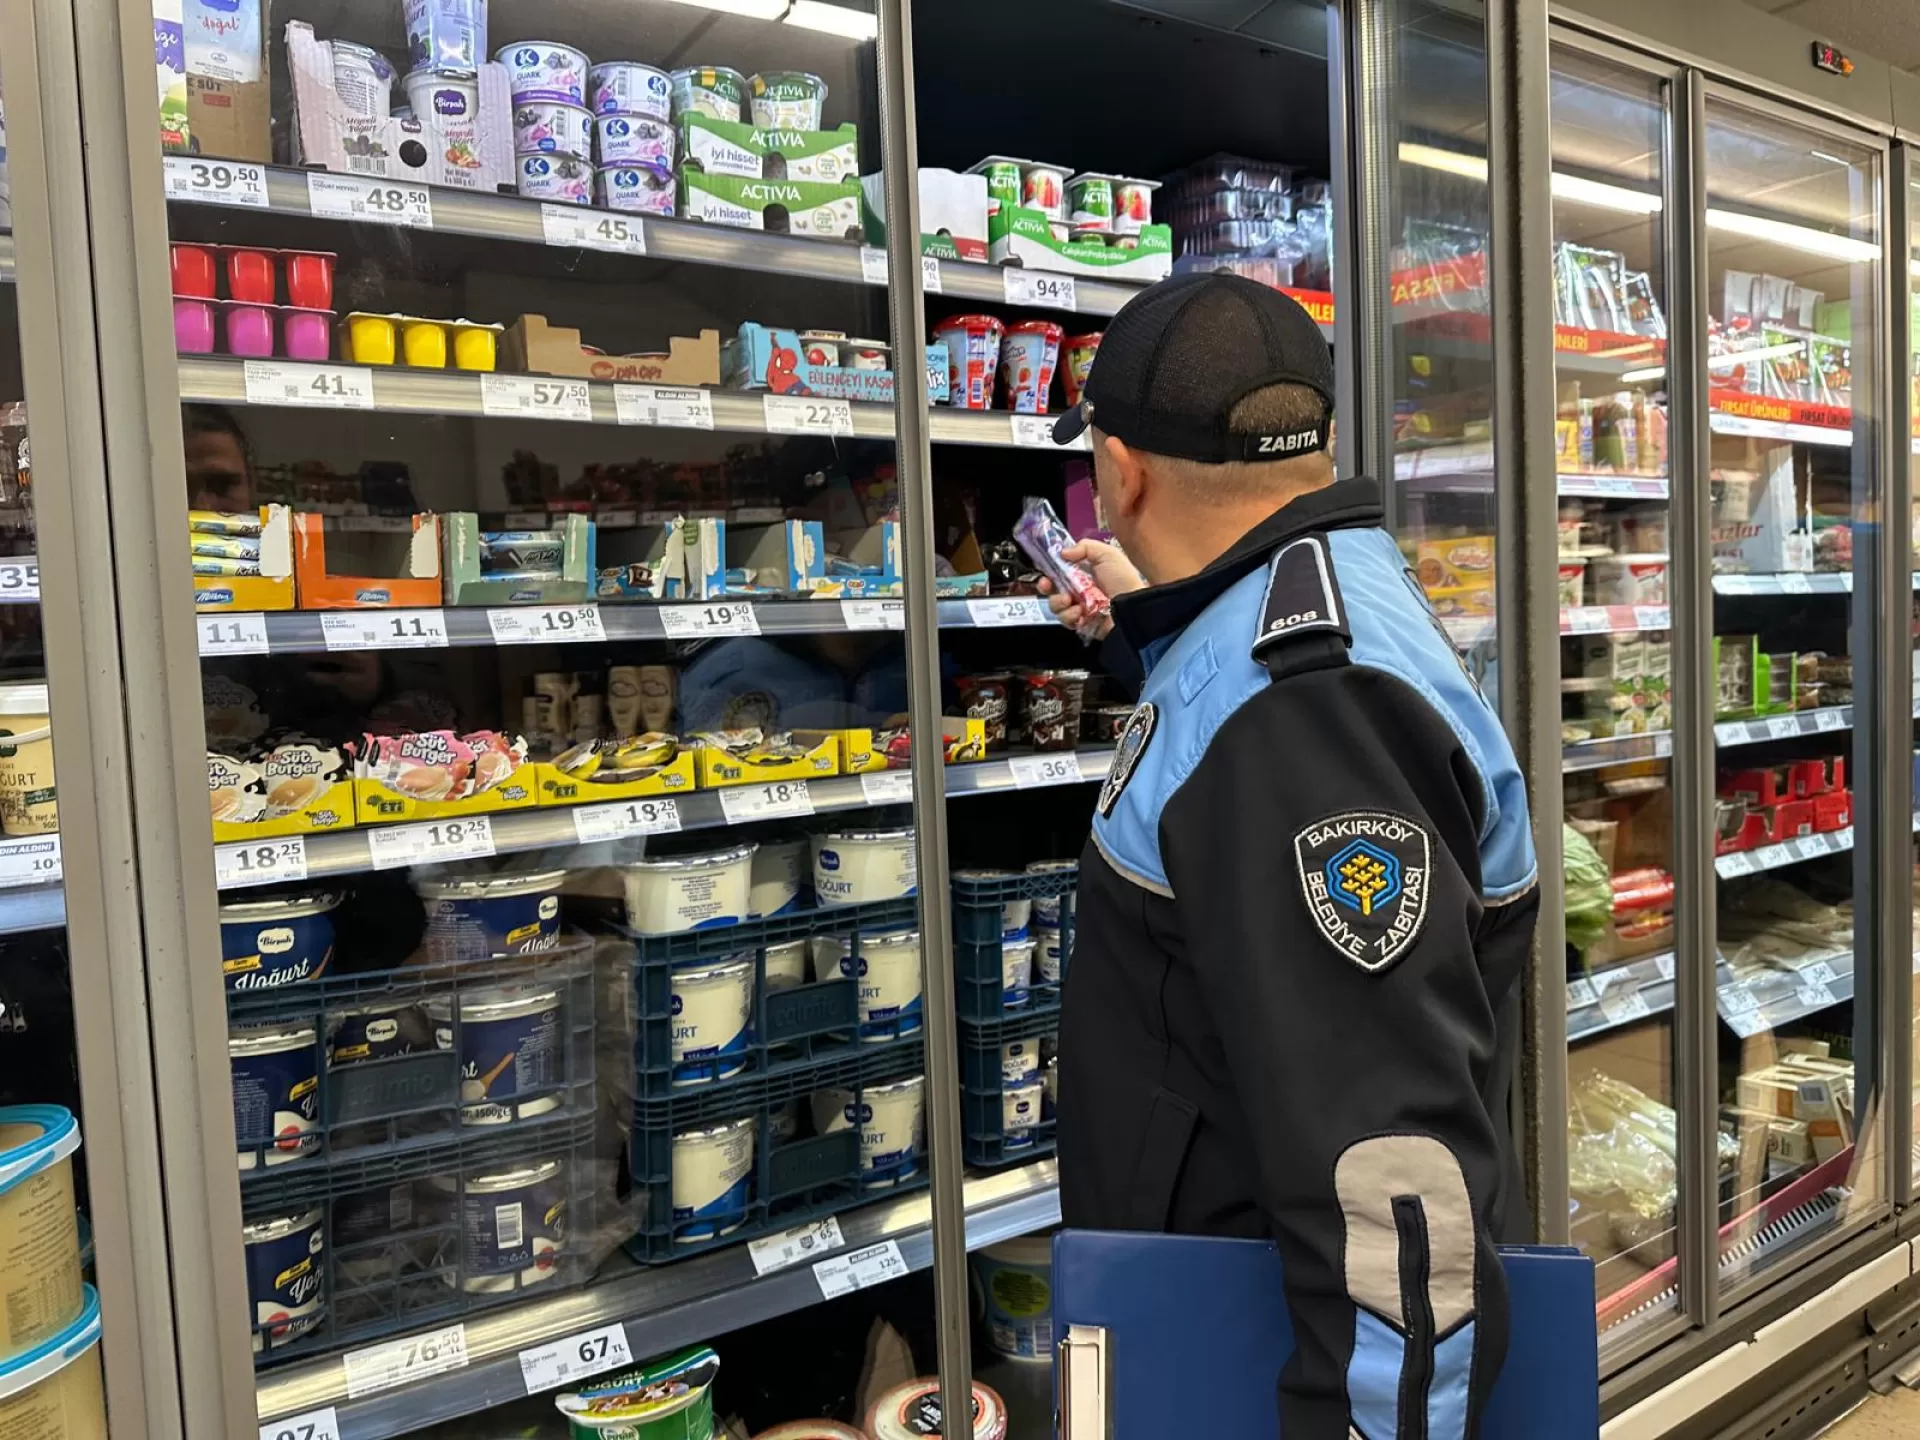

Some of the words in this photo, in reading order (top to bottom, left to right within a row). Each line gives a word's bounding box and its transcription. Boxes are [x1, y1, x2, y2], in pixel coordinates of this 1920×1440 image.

[749, 130, 805, 148] ACTIVIA
[366, 188, 427, 212] 48,50
[740, 185, 802, 201] ACTIVIA
[596, 218, 629, 241] 45
[311, 374, 348, 396] 41
[534, 383, 588, 406] 57,50
[1259, 430, 1319, 452] ZABITA
[542, 608, 595, 632] 19,50
[703, 605, 750, 626] 19,50
[1270, 610, 1318, 631] 608
[207, 622, 247, 643] 11
[390, 618, 427, 638] 11
[418, 734, 449, 752] Süt
[279, 750, 311, 765] Süt
[401, 743, 457, 766] Burger
[0, 772, 36, 787] ĞURT
[266, 760, 323, 779] Burger
[763, 783, 807, 805] 18,25
[626, 801, 675, 824] 18,25
[428, 820, 486, 847] 18,25
[1307, 820, 1414, 848] BAKIRKÖY
[236, 843, 301, 871] 18,25
[1307, 870, 1367, 956] BELEDİYE
[1374, 866, 1424, 956] ZABITASI
[858, 986, 881, 999] URT
[672, 1025, 698, 1039] URT
[861, 1131, 886, 1145] URT
[578, 1336, 609, 1363] 67
[612, 1343, 625, 1353] TL
